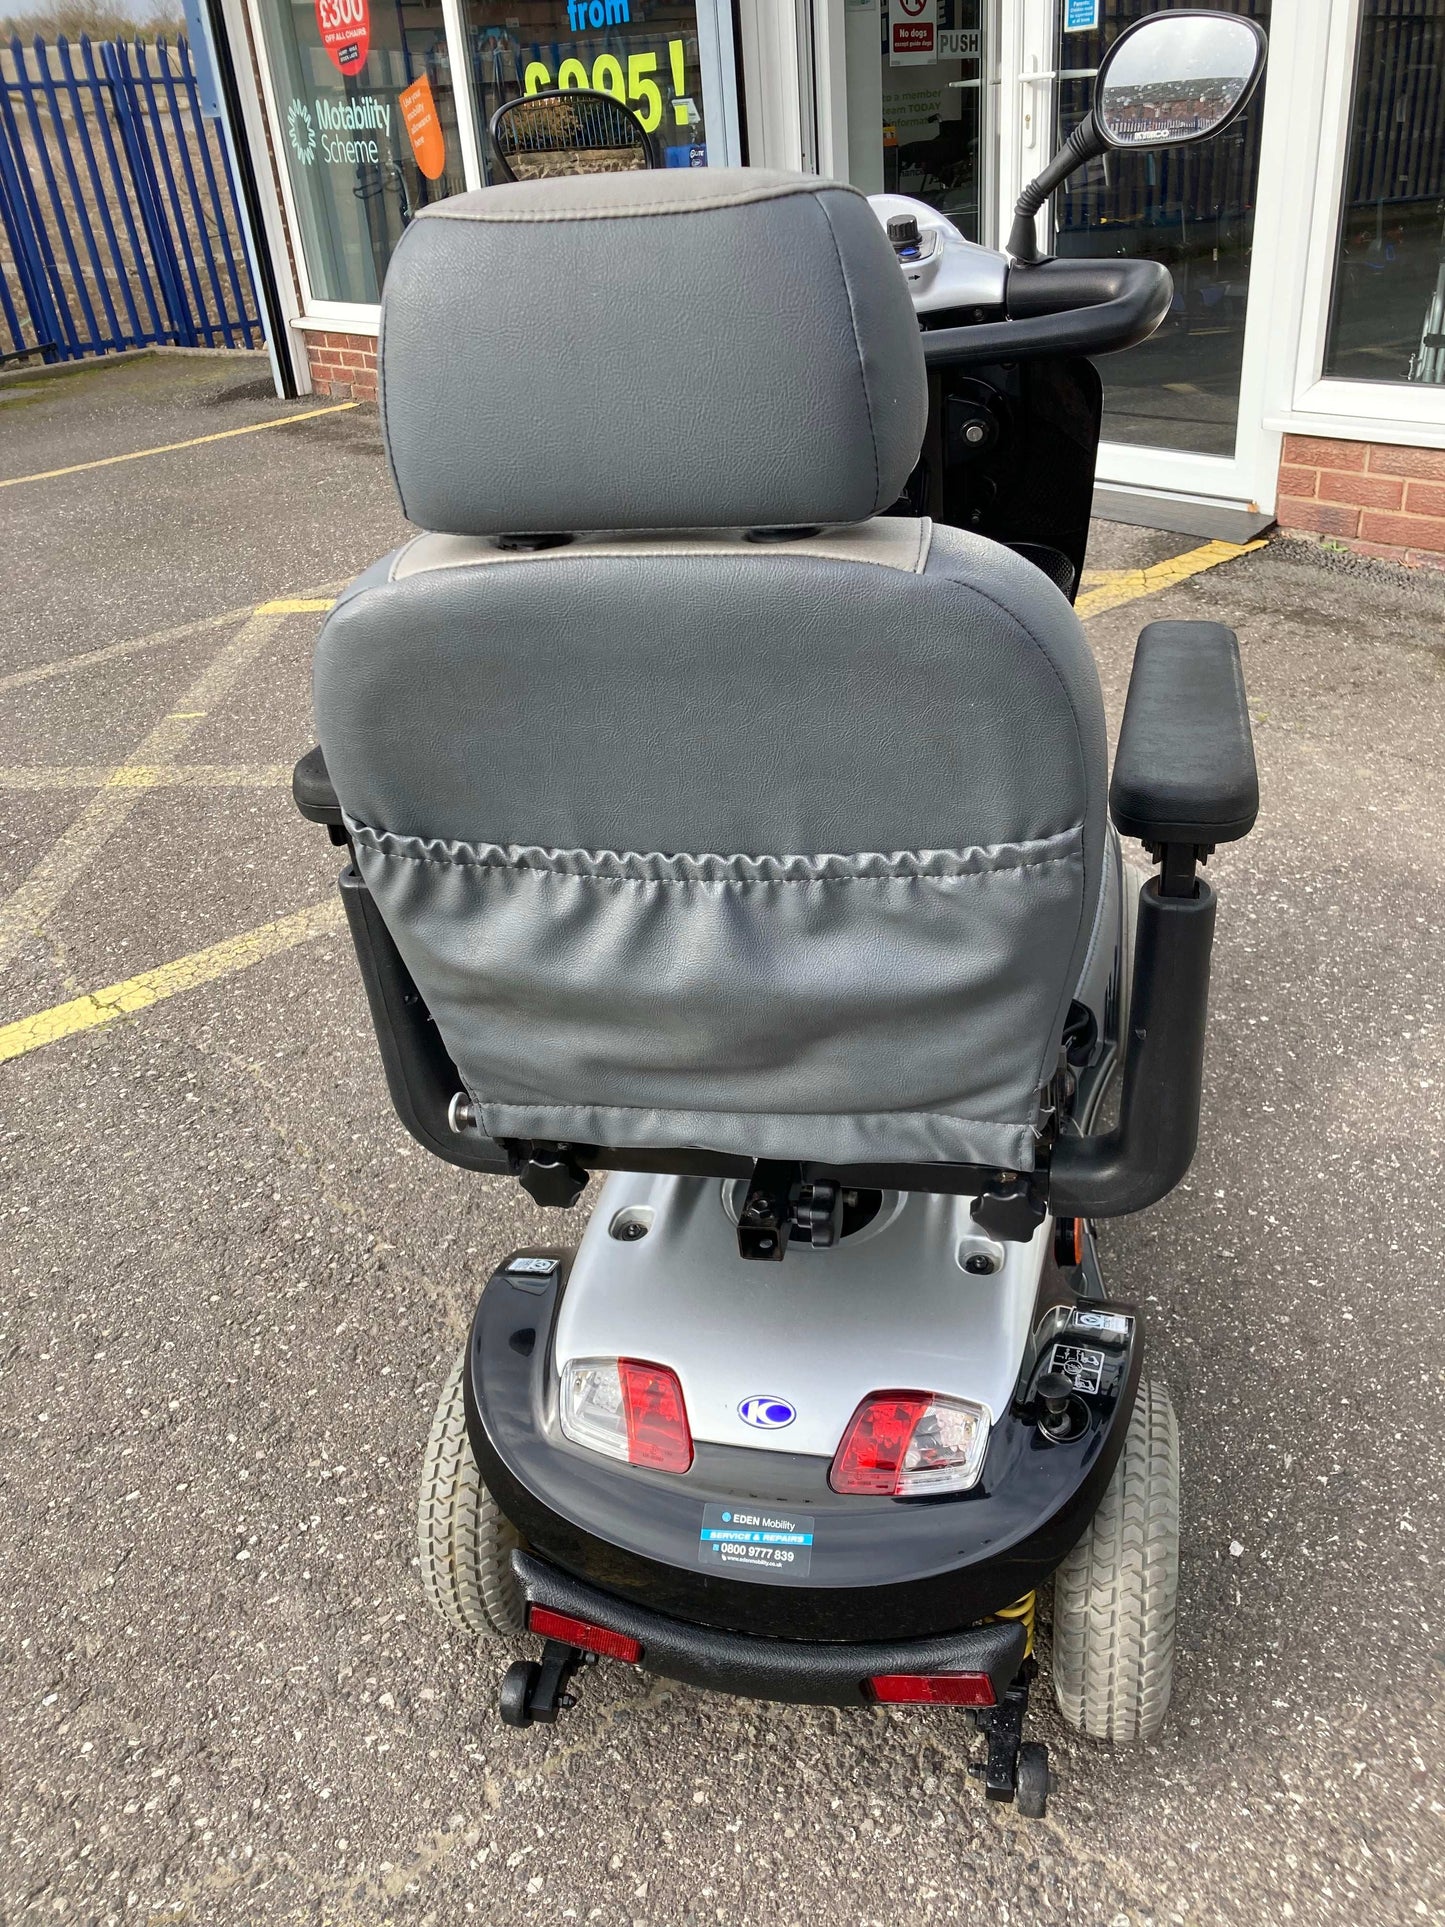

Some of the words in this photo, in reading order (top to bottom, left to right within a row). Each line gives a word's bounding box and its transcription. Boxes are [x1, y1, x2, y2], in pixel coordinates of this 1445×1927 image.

[319, 0, 365, 28] £300
[567, 0, 630, 32] from
[325, 33, 335, 43] OFF
[336, 31, 346, 40] ALL
[899, 28, 909, 37] No
[910, 28, 927, 38] dogs
[940, 33, 978, 53] PUSH
[902, 89, 941, 100] member
[315, 96, 390, 137] Motability
[908, 102, 941, 113] TODAY
[321, 134, 379, 164] Scheme
[733, 1513, 760, 1526] EDEN
[762, 1518, 796, 1532] Mobility
[709, 1532, 751, 1541] SERVICE
[752, 1533, 760, 1541] &
[763, 1534, 804, 1543] REPAIRS
[721, 1542, 747, 1555] 0800
[748, 1546, 773, 1559] 9777
[774, 1550, 795, 1562] 839
